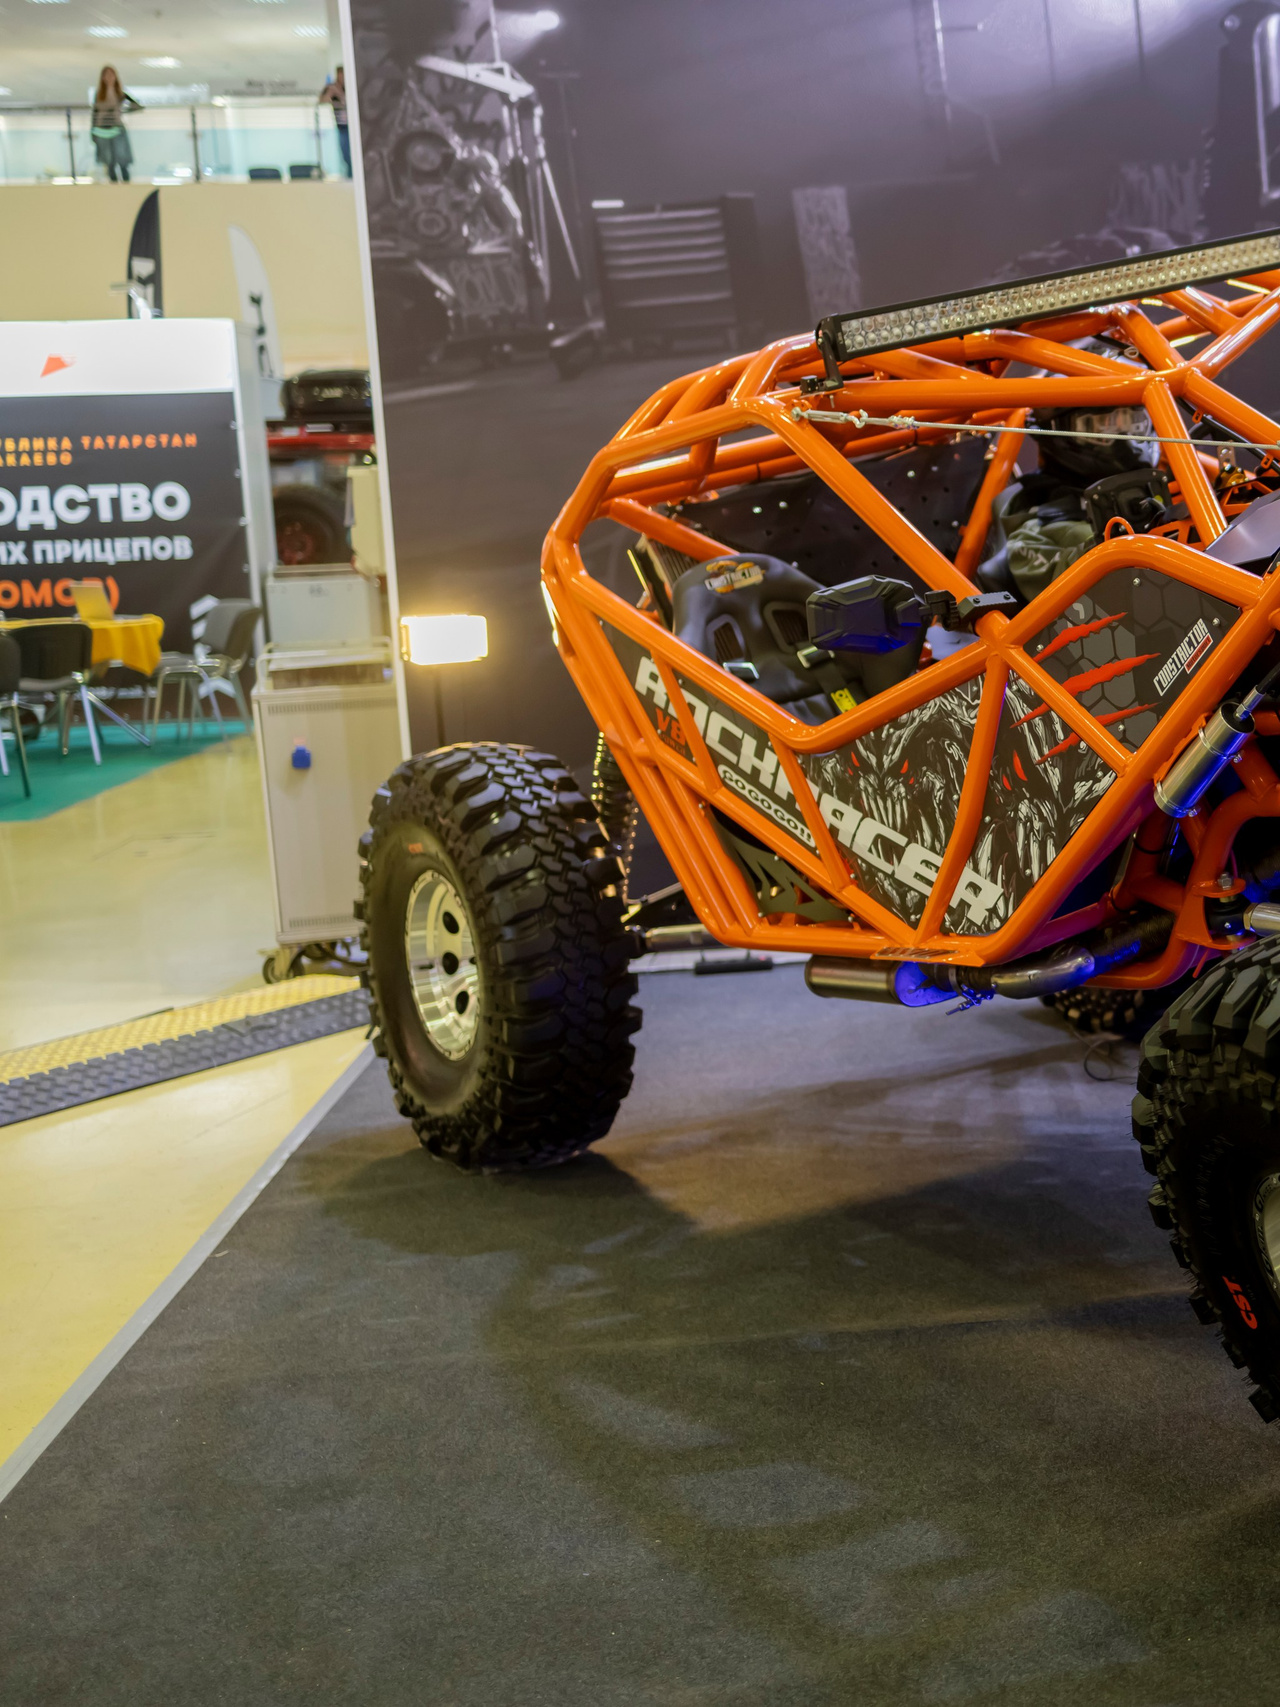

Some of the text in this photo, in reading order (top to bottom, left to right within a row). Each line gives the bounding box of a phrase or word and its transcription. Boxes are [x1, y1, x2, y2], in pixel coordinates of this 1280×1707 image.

[0, 433, 198, 452] БЛИКА ТАТАРСТАН
[32, 535, 194, 565] ПРИЦЕПОВ
[1153, 618, 1209, 696] CONSTRICTOR
[655, 707, 687, 747] V8
[1222, 1275, 1257, 1329] CST
